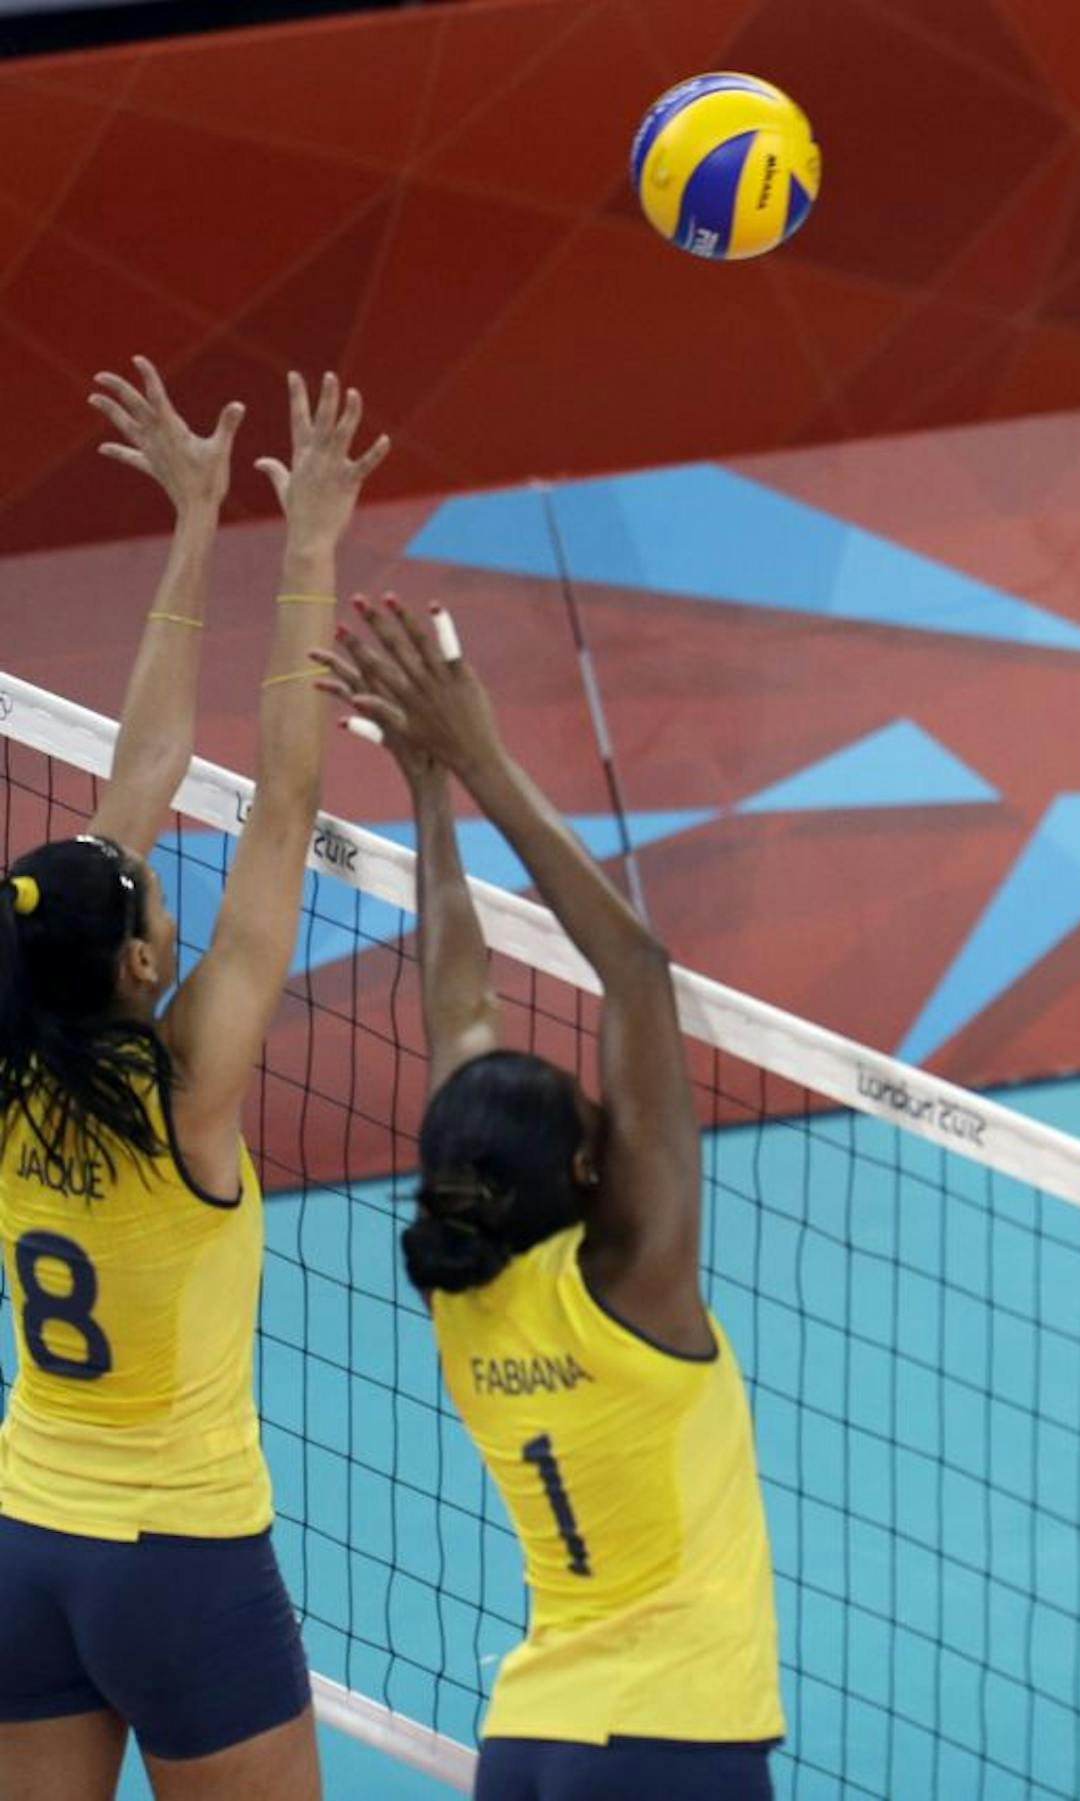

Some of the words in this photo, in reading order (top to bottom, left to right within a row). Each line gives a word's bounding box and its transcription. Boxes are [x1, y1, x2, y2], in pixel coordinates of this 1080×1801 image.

[16, 1142, 105, 1200] JAQUE
[14, 1229, 113, 1381] 8
[469, 1353, 596, 1397] FABIANA
[521, 1432, 594, 1577] 1
